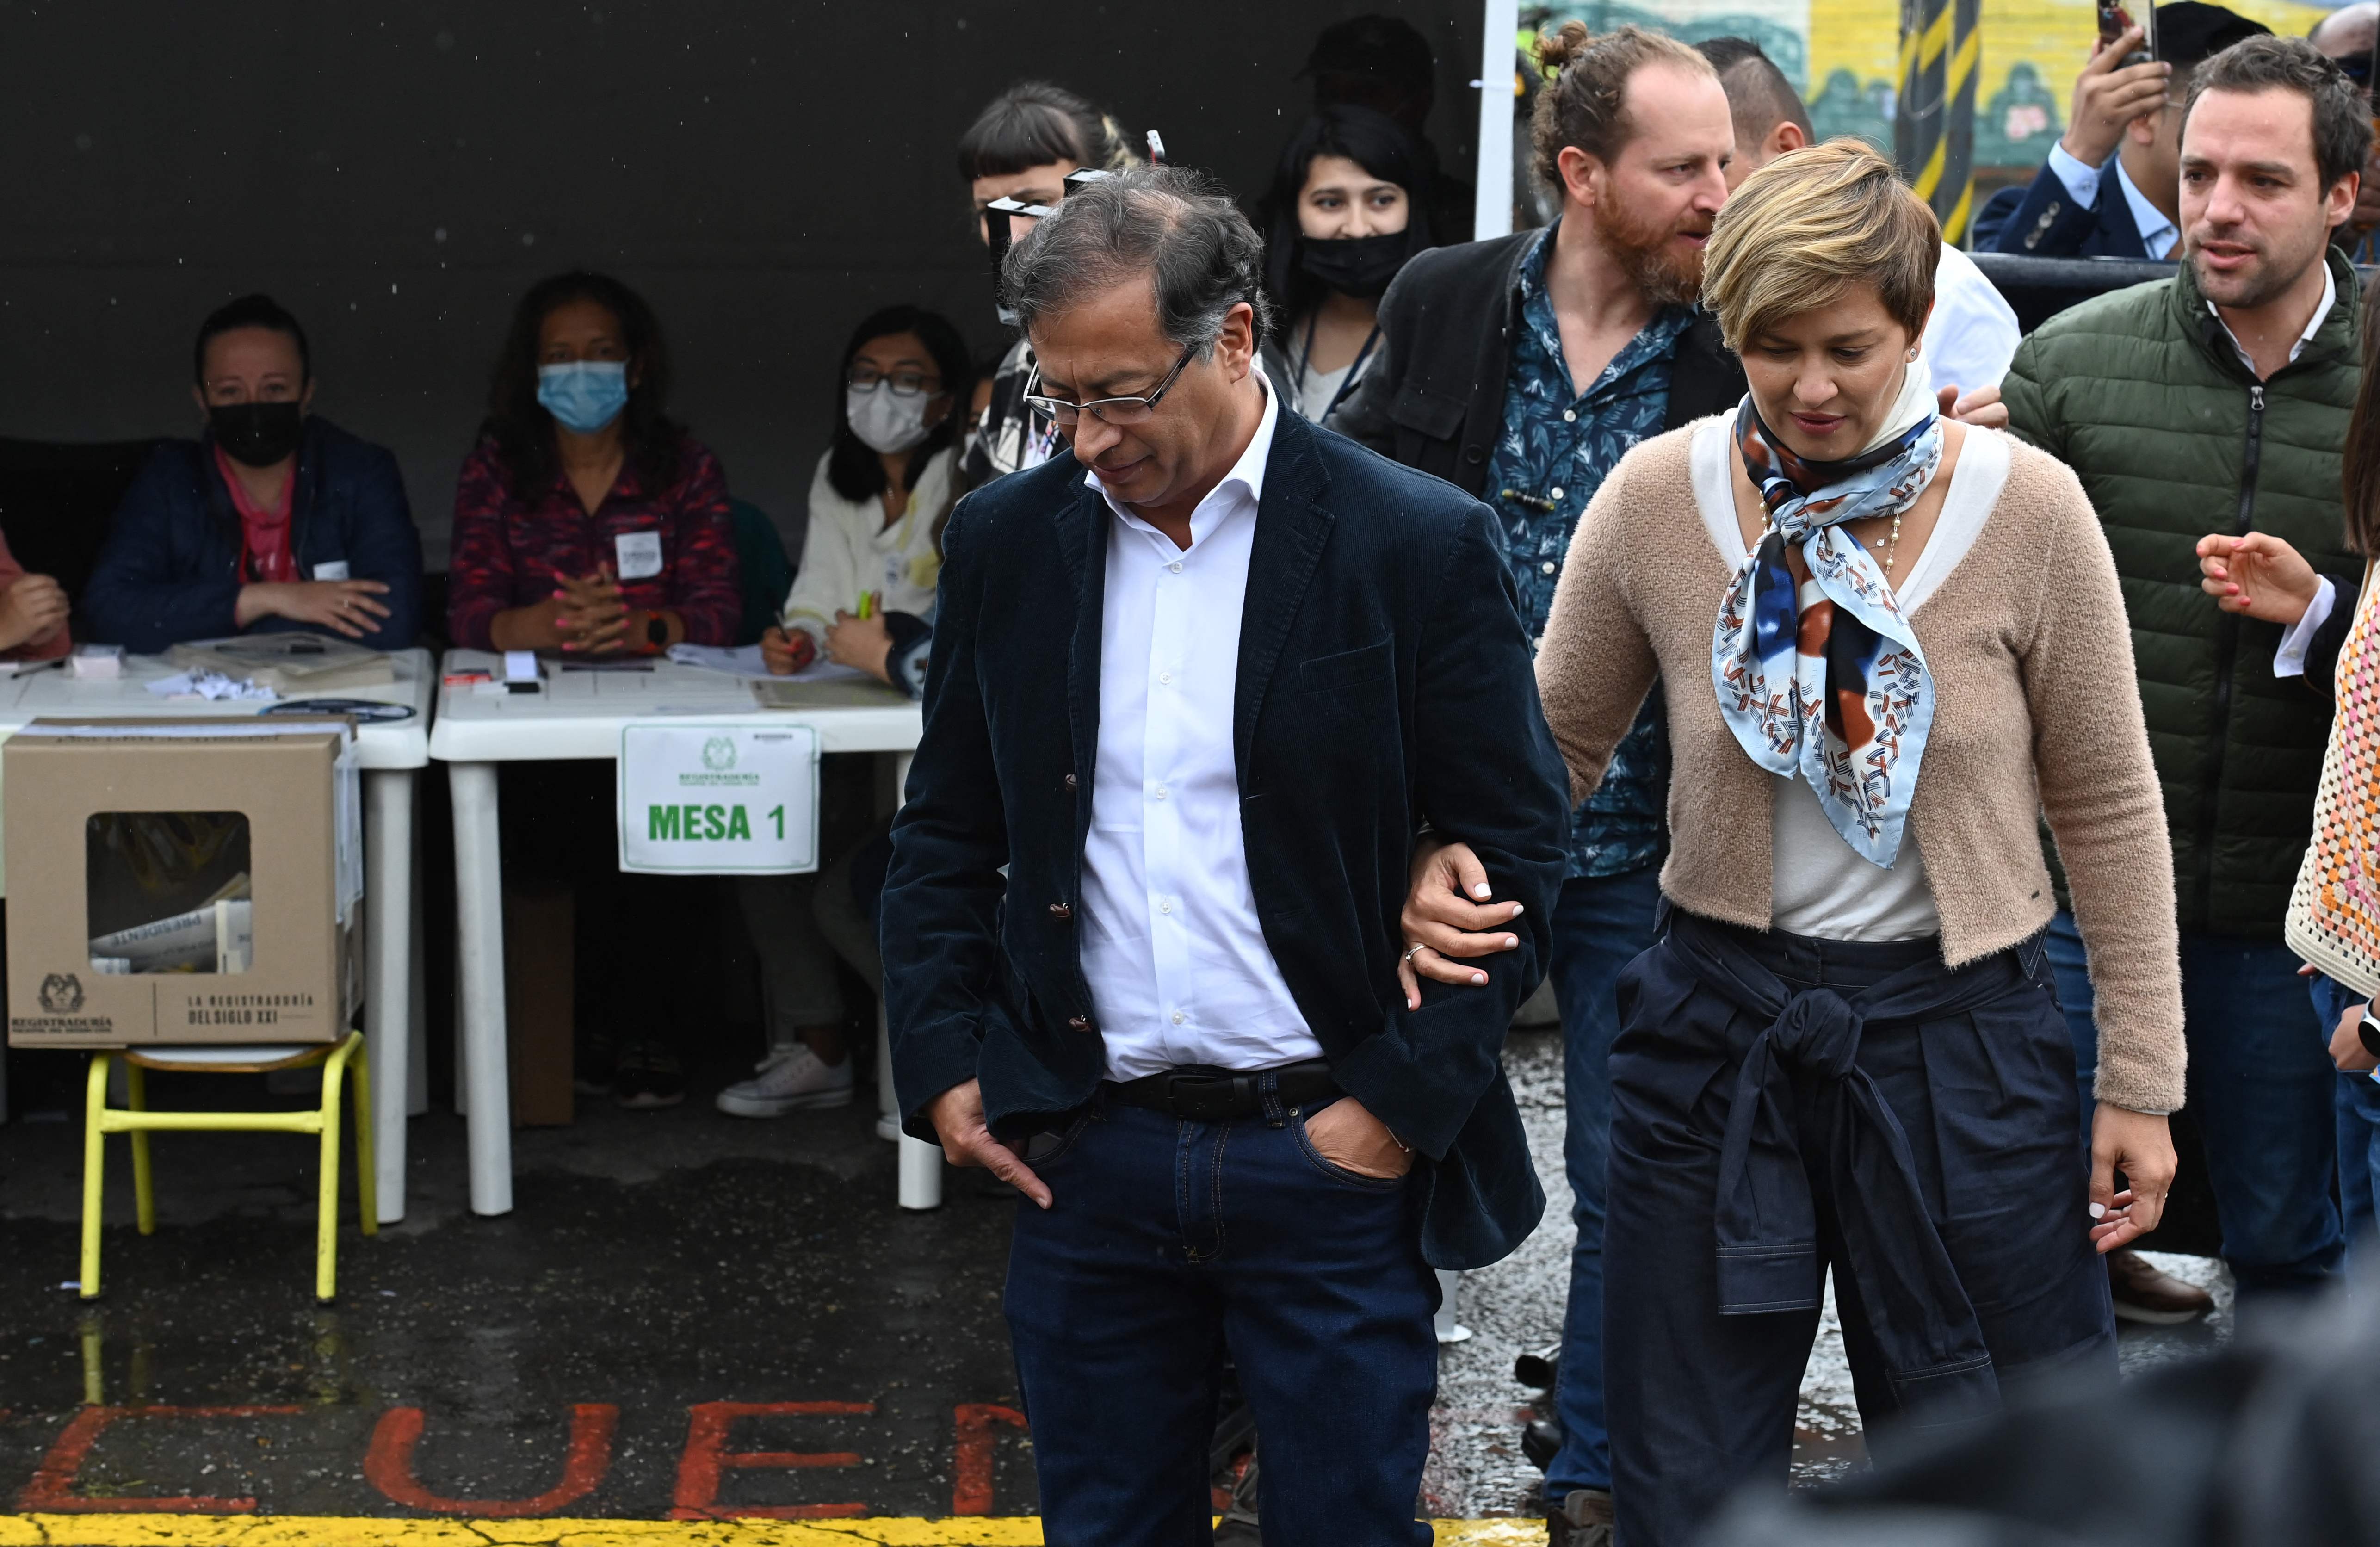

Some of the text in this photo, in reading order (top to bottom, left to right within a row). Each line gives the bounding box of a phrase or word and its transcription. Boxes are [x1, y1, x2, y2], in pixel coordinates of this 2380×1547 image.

[649, 804, 784, 840] MESA 1
[188, 993, 313, 1007] LA REGISTRADURÍA
[188, 1009, 278, 1025] DEL SIGLO XXI
